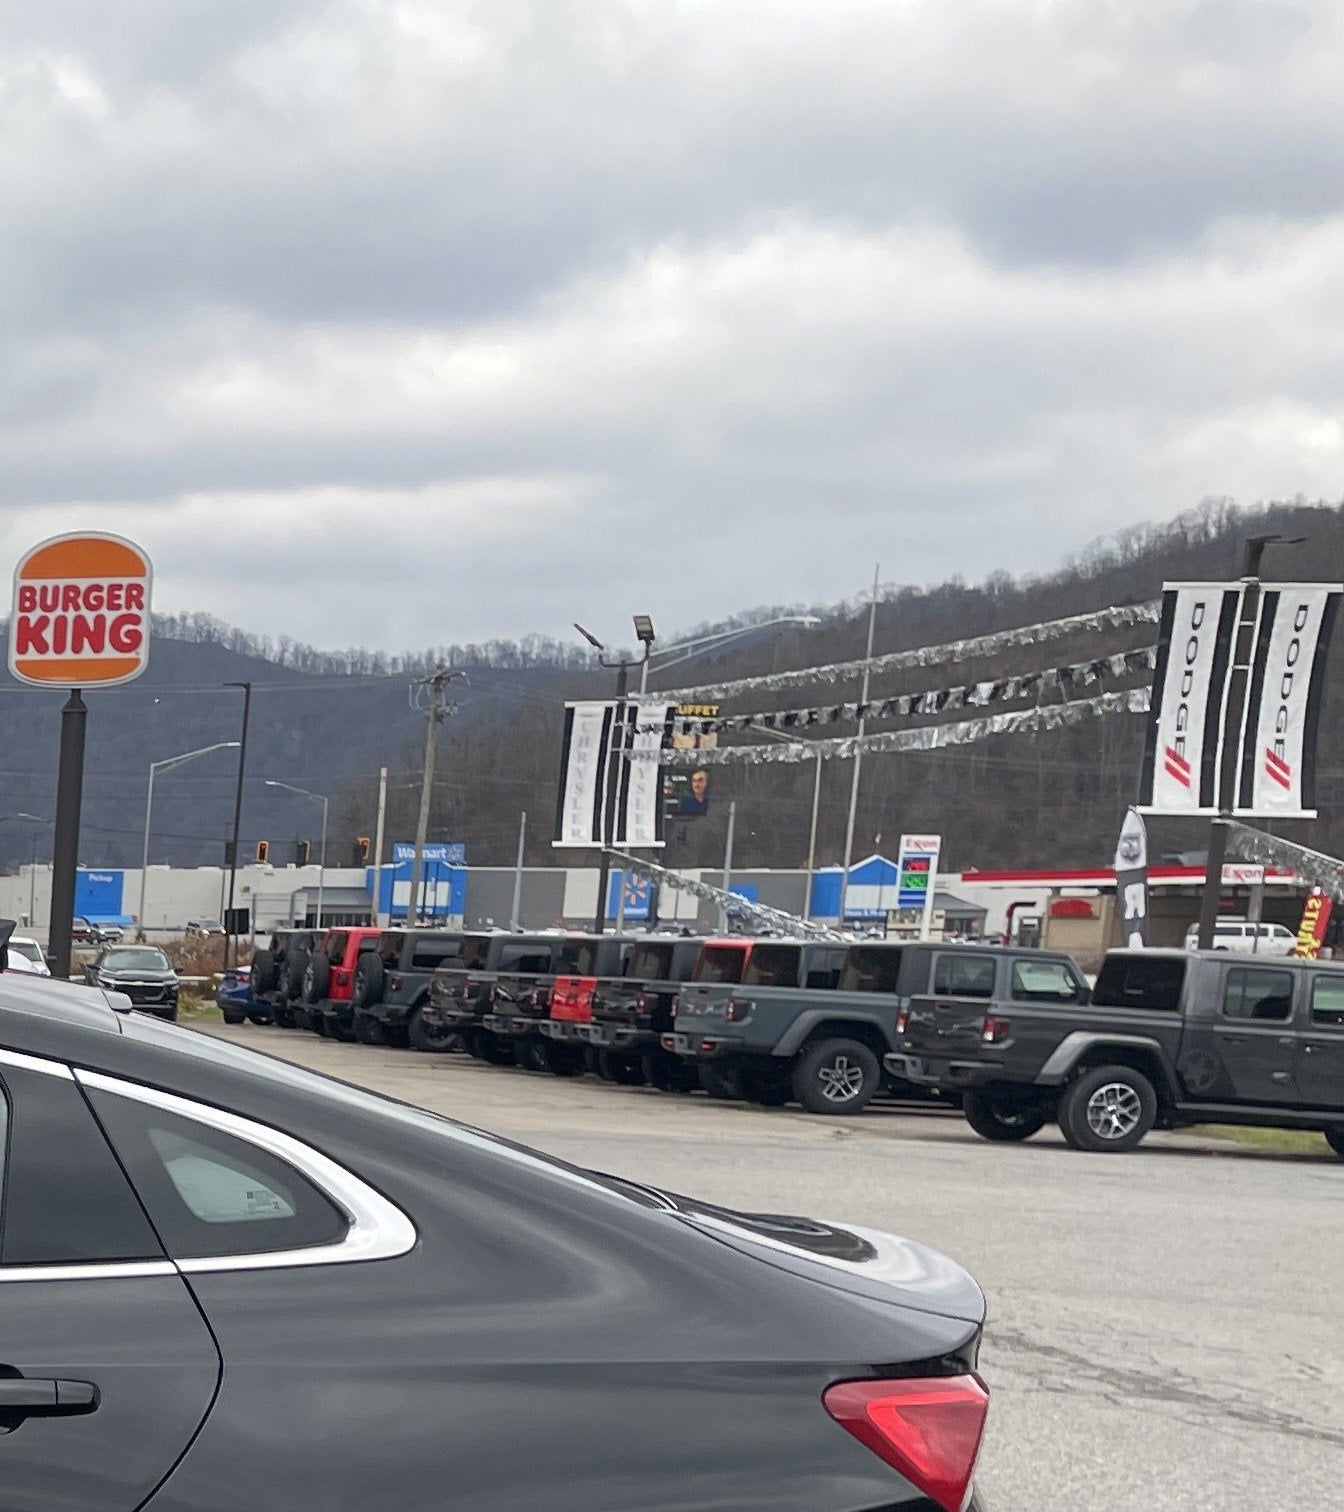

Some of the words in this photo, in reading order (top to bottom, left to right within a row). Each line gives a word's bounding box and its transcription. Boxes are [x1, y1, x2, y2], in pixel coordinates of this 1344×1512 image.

[16, 613, 143, 655] KING
[18, 583, 145, 613] BURGER
[676, 704, 719, 717] UFFET
[1175, 602, 1206, 764] DODGE
[1274, 604, 1309, 765] DODGE
[571, 722, 593, 840] CHRYSLER
[634, 736, 655, 840] HYSLER
[397, 846, 447, 859] Wamart
